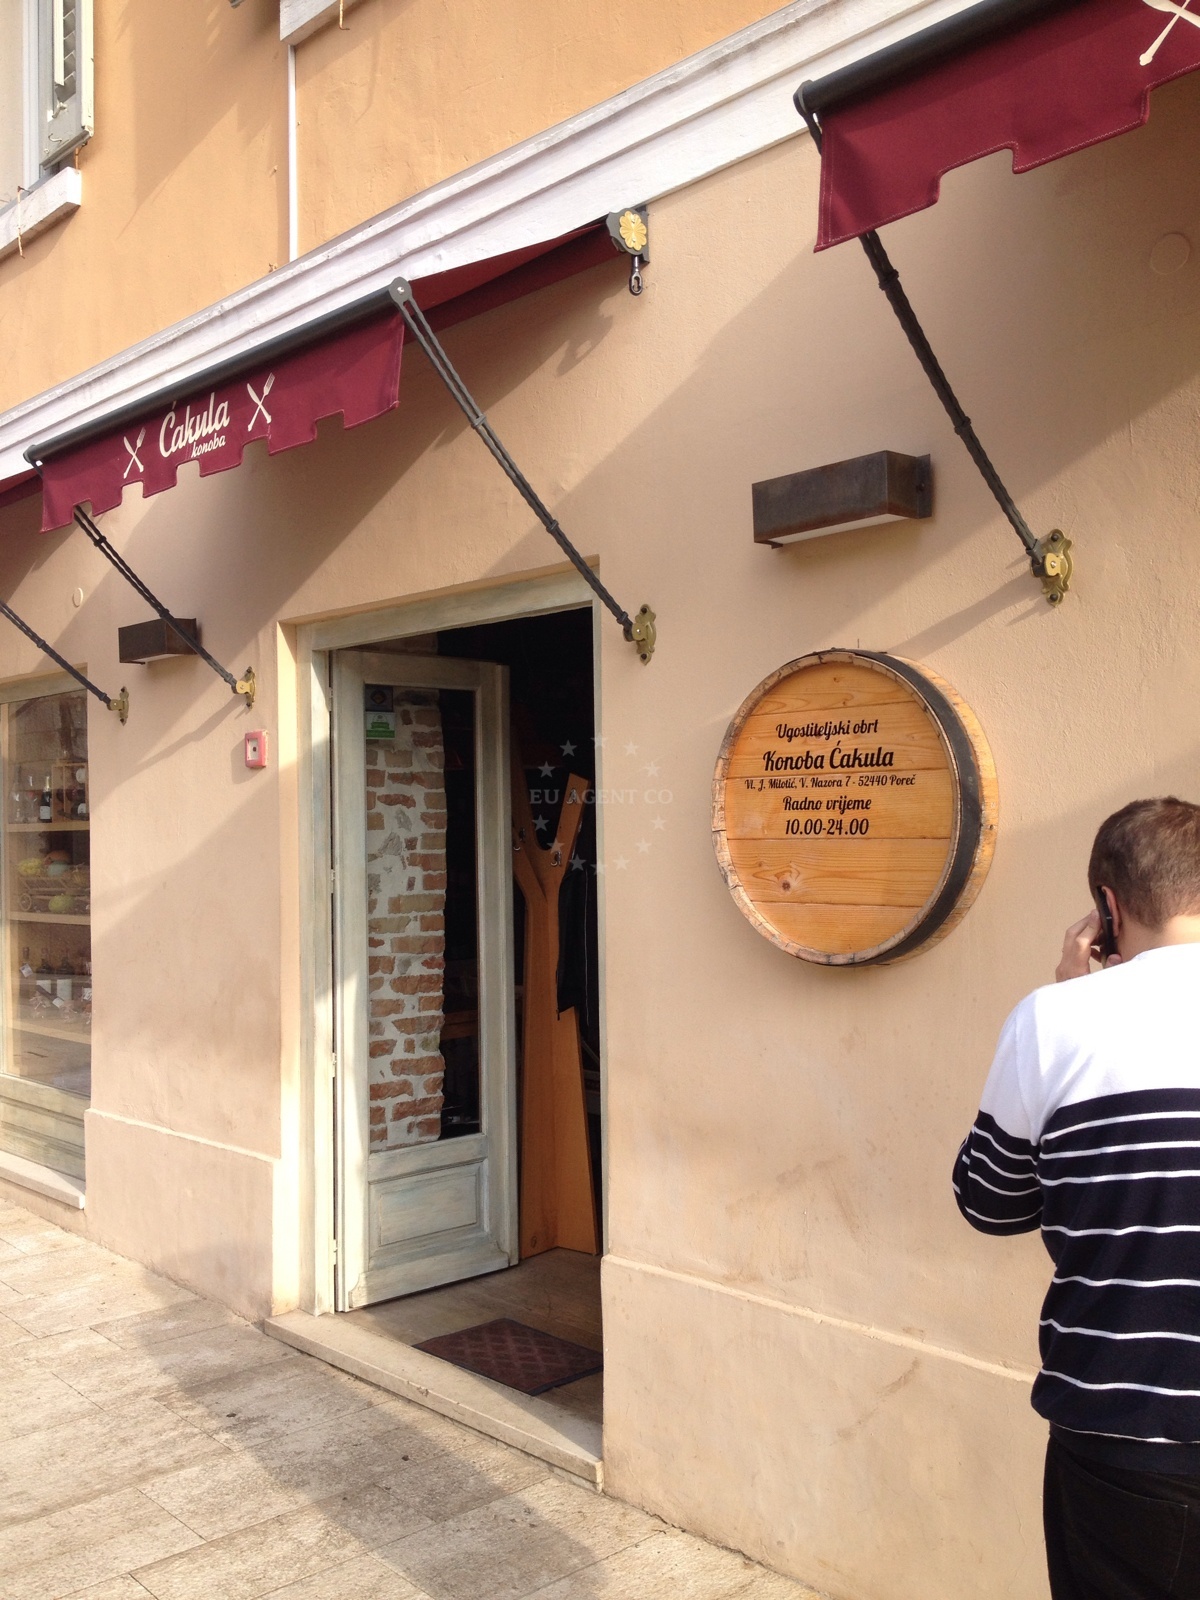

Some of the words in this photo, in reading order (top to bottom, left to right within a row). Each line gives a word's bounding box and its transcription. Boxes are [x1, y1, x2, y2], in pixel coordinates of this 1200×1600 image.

[159, 392, 230, 458] Ćakula
[191, 434, 226, 458] konoba
[776, 719, 851, 743] Ugostiteljski
[852, 719, 879, 735] obrt
[762, 750, 825, 772] Konoba
[829, 740, 895, 770] Ćakula
[799, 777, 809, 789] V.
[811, 777, 843, 789] Nazora
[845, 776, 852, 787] 7
[857, 775, 888, 787] 52440
[889, 774, 917, 786] Poreč
[782, 795, 823, 811] Radno
[826, 795, 872, 815] vrijeme
